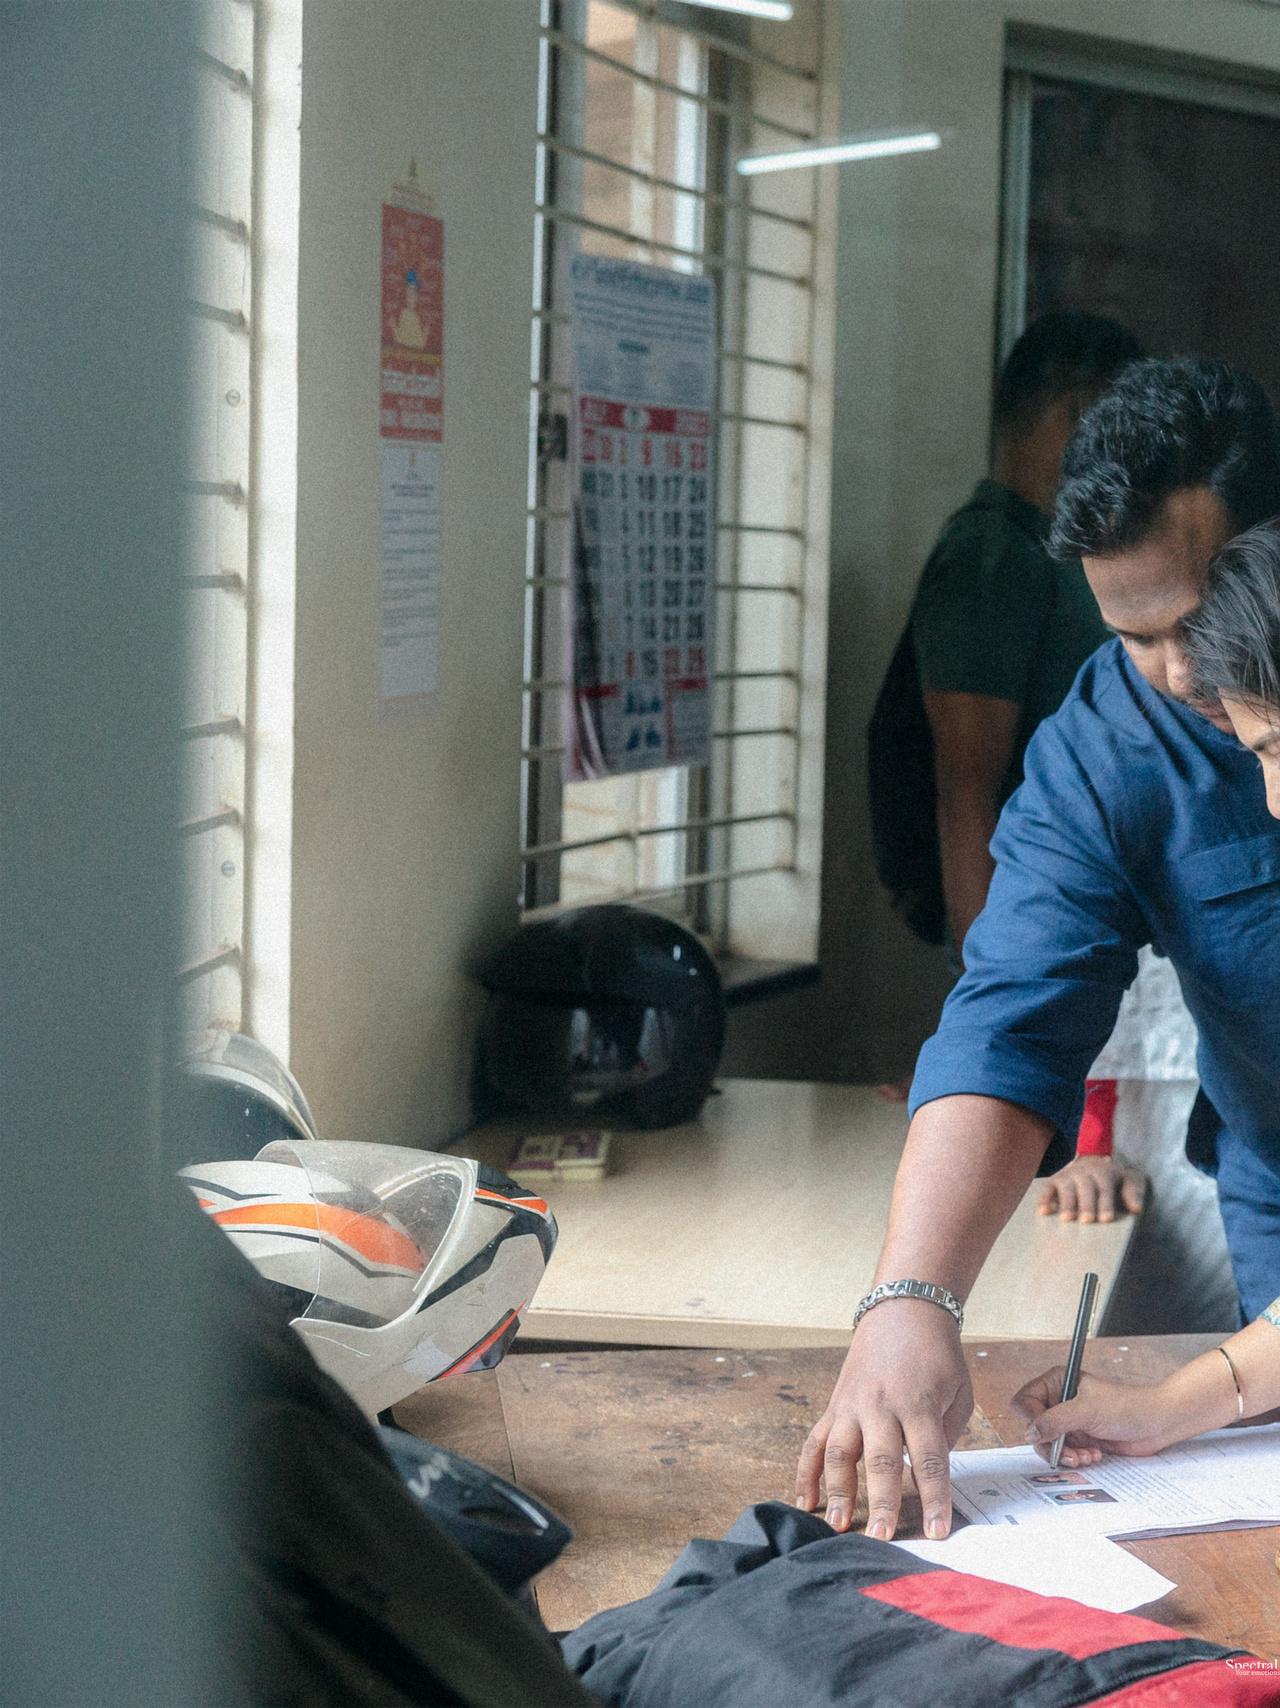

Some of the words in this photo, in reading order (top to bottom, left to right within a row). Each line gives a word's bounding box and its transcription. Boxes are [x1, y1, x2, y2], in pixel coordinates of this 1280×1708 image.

[638, 475, 656, 501] 10
[663, 475, 682, 503] 17
[690, 476, 707, 504] 24
[638, 510, 655, 535] 11
[663, 511, 682, 538] 18
[638, 545, 656, 573] 12
[663, 580, 681, 608] 20
[687, 579, 705, 608] 27
[641, 614, 656, 641] 14
[663, 614, 681, 642] 21
